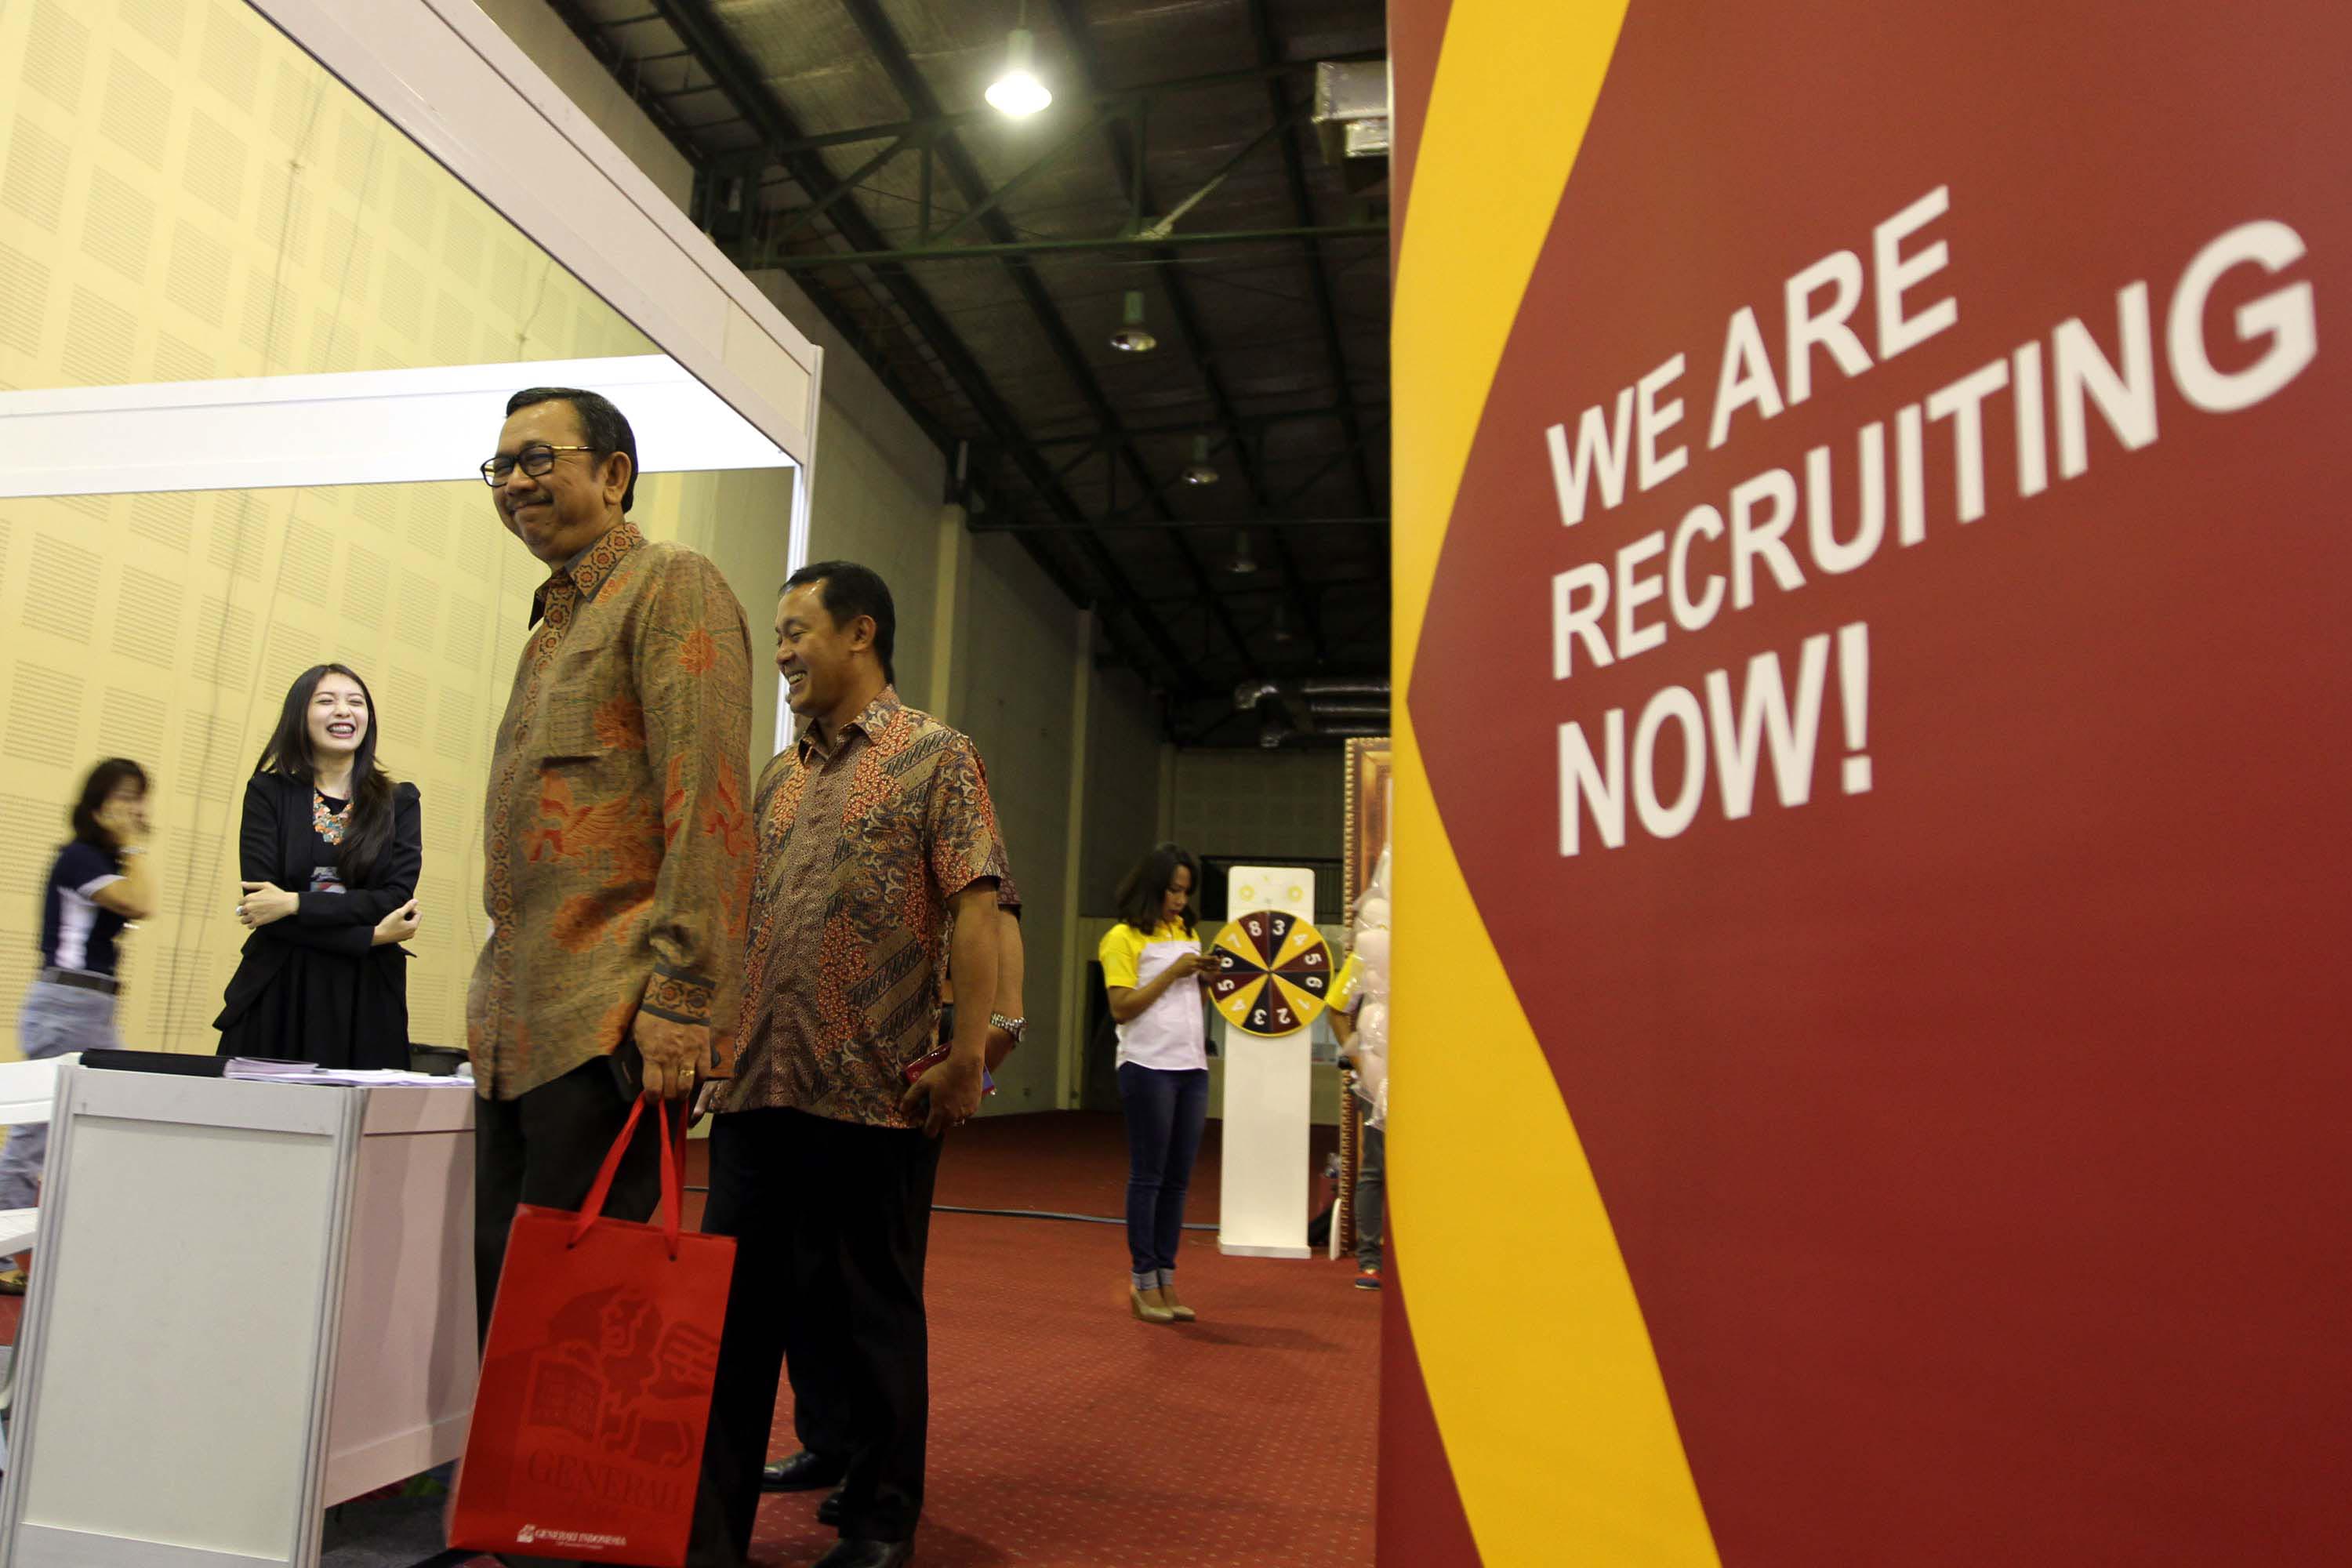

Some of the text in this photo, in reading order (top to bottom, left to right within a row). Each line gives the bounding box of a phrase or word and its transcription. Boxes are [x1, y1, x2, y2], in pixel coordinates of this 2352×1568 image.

[1547, 187, 1957, 527] WE ARE
[1552, 220, 2316, 681] RECRUITING
[1559, 623, 1871, 857] NOW!
[1248, 920, 1262, 937] 8
[1272, 920, 1285, 935] 3
[1227, 934, 1241, 948] 7
[1294, 933, 1308, 946] 4
[1305, 953, 1322, 965] 5
[1217, 979, 1235, 991] 5
[1305, 977, 1323, 989] 6
[1254, 1009, 1267, 1025] 3
[1276, 1008, 1290, 1024] 2
